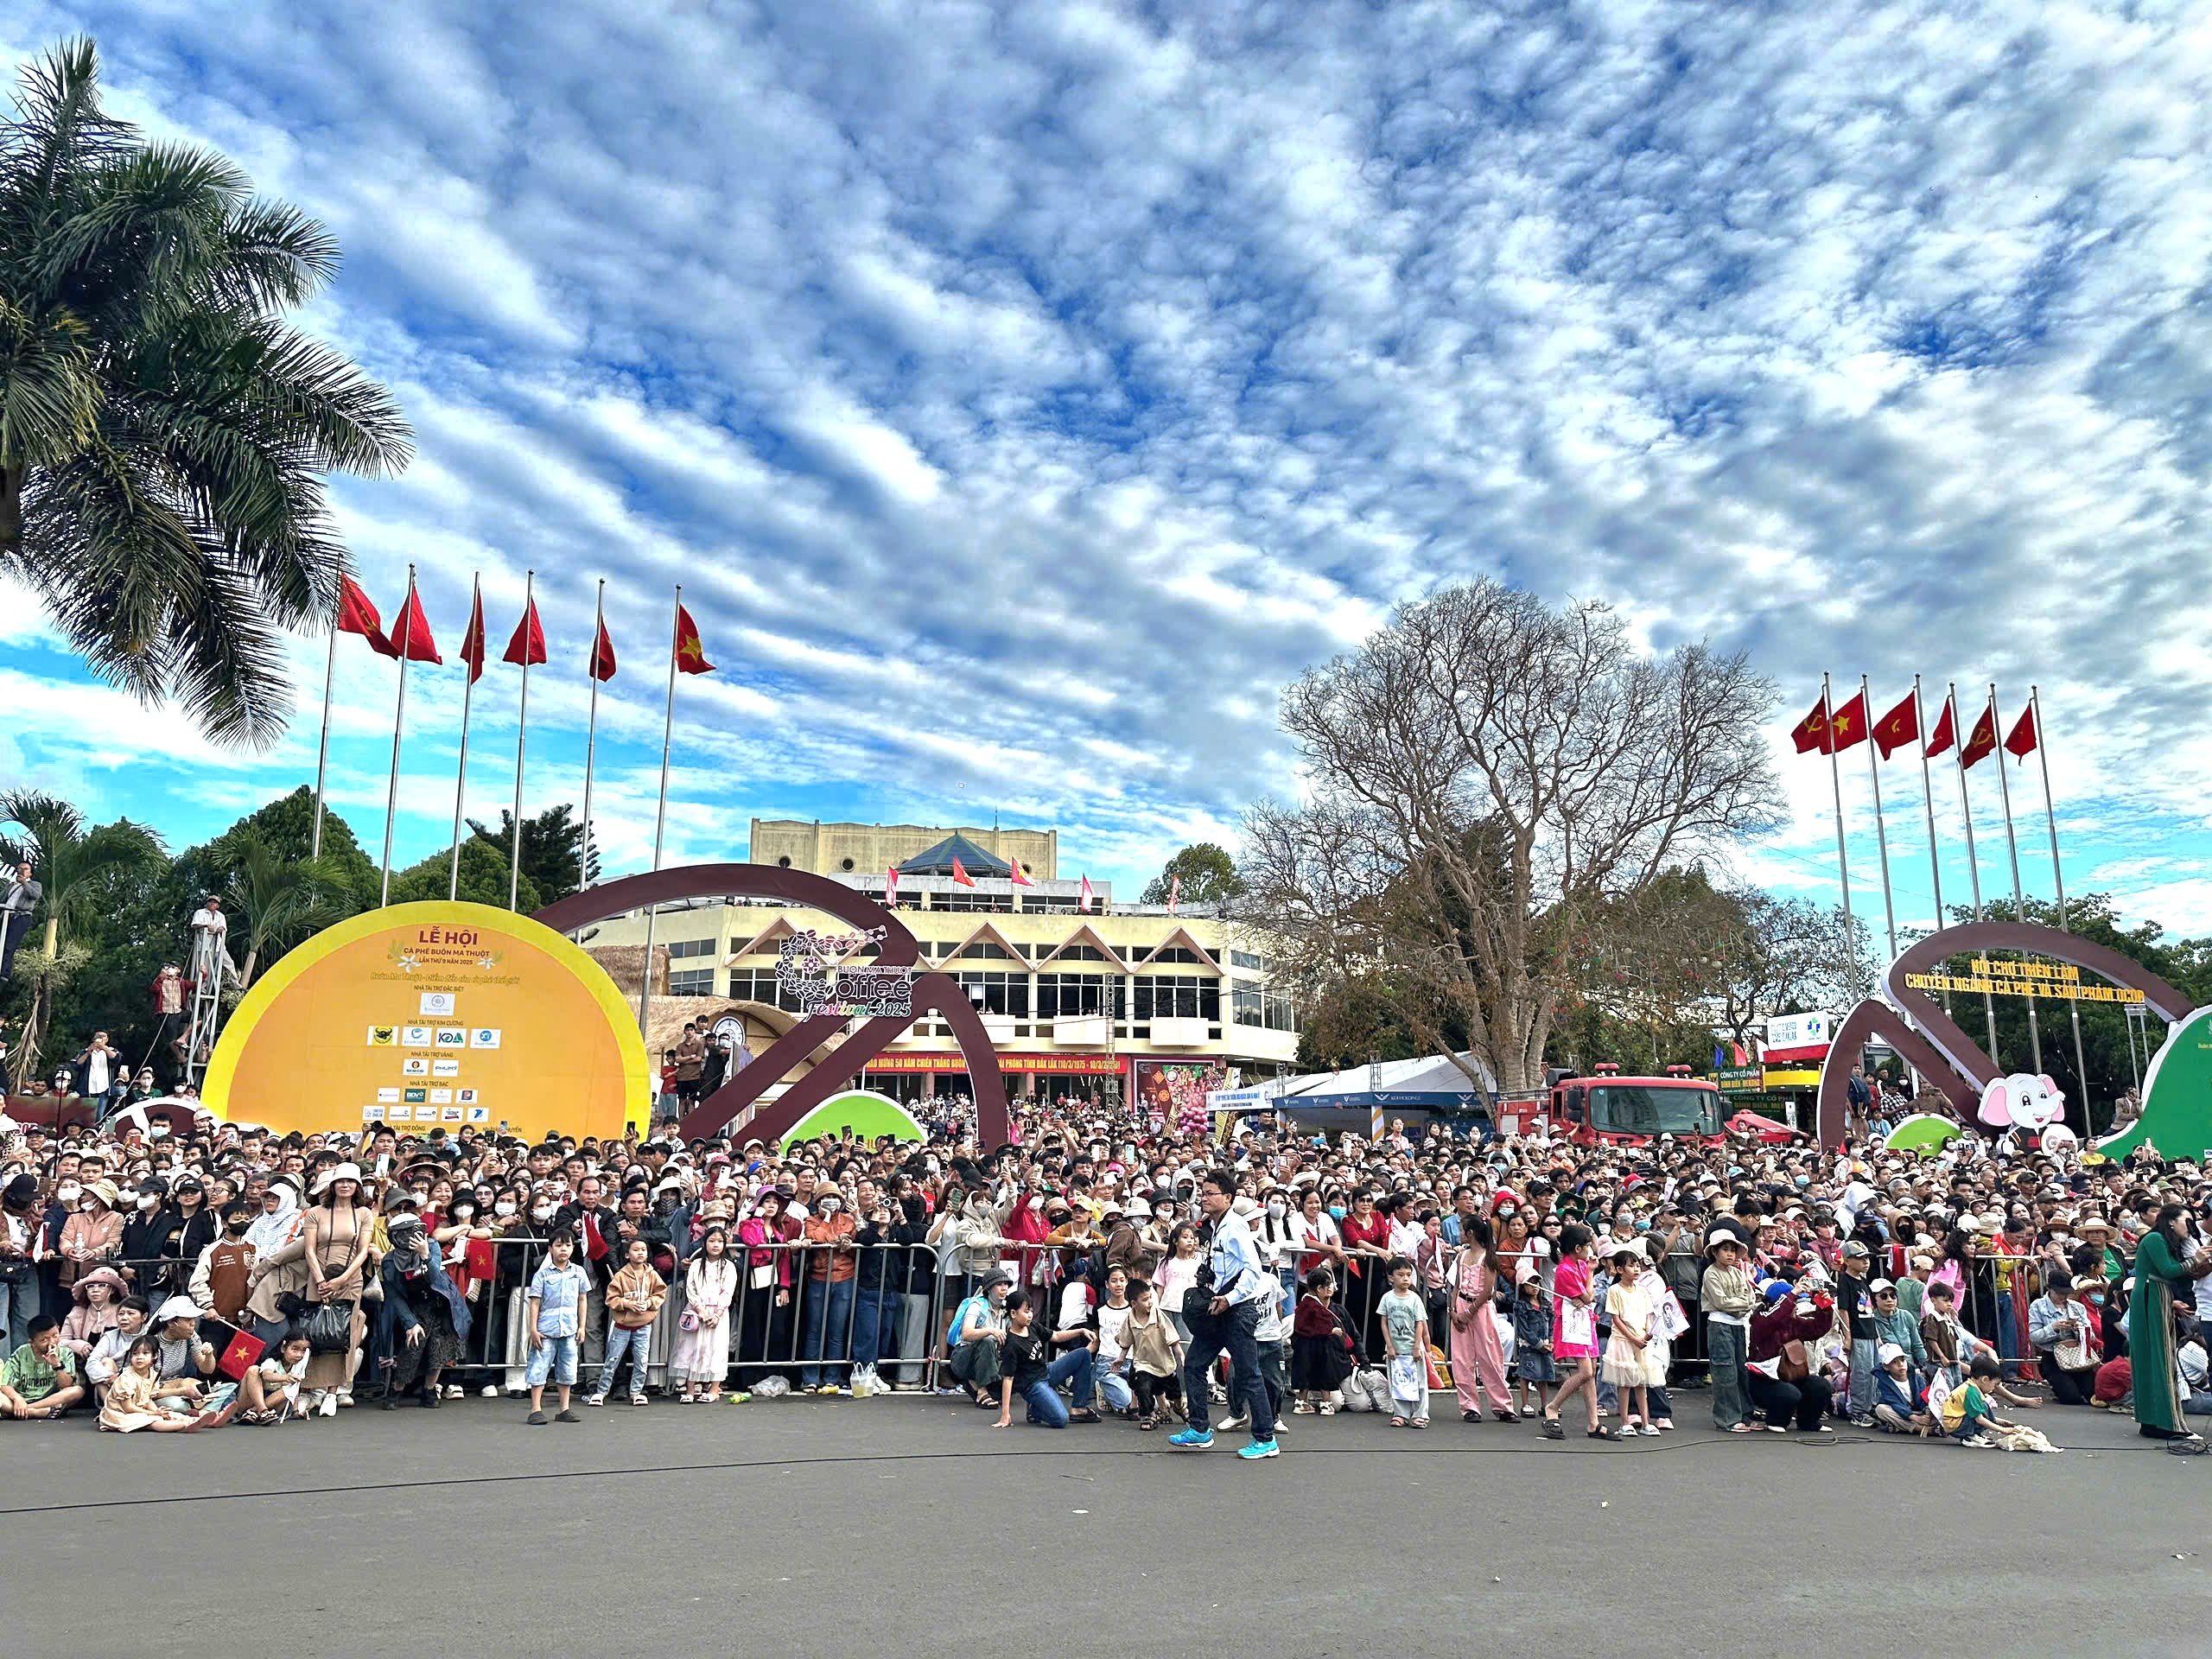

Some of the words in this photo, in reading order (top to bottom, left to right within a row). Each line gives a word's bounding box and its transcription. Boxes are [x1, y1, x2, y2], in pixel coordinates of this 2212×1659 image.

[419, 925, 440, 944] LỄ
[445, 929, 478, 948] HỘI
[466, 950, 489, 958] THUỘT
[1993, 960, 2016, 979] CHỢ
[2117, 988, 2145, 1003] OCOP
[803, 1000, 874, 1022] Festival
[875, 1002, 912, 1017] 2025
[895, 1058, 902, 1068] 50
[904, 1057, 915, 1068] NĂM
[1739, 1069, 1745, 1077] CỔ
